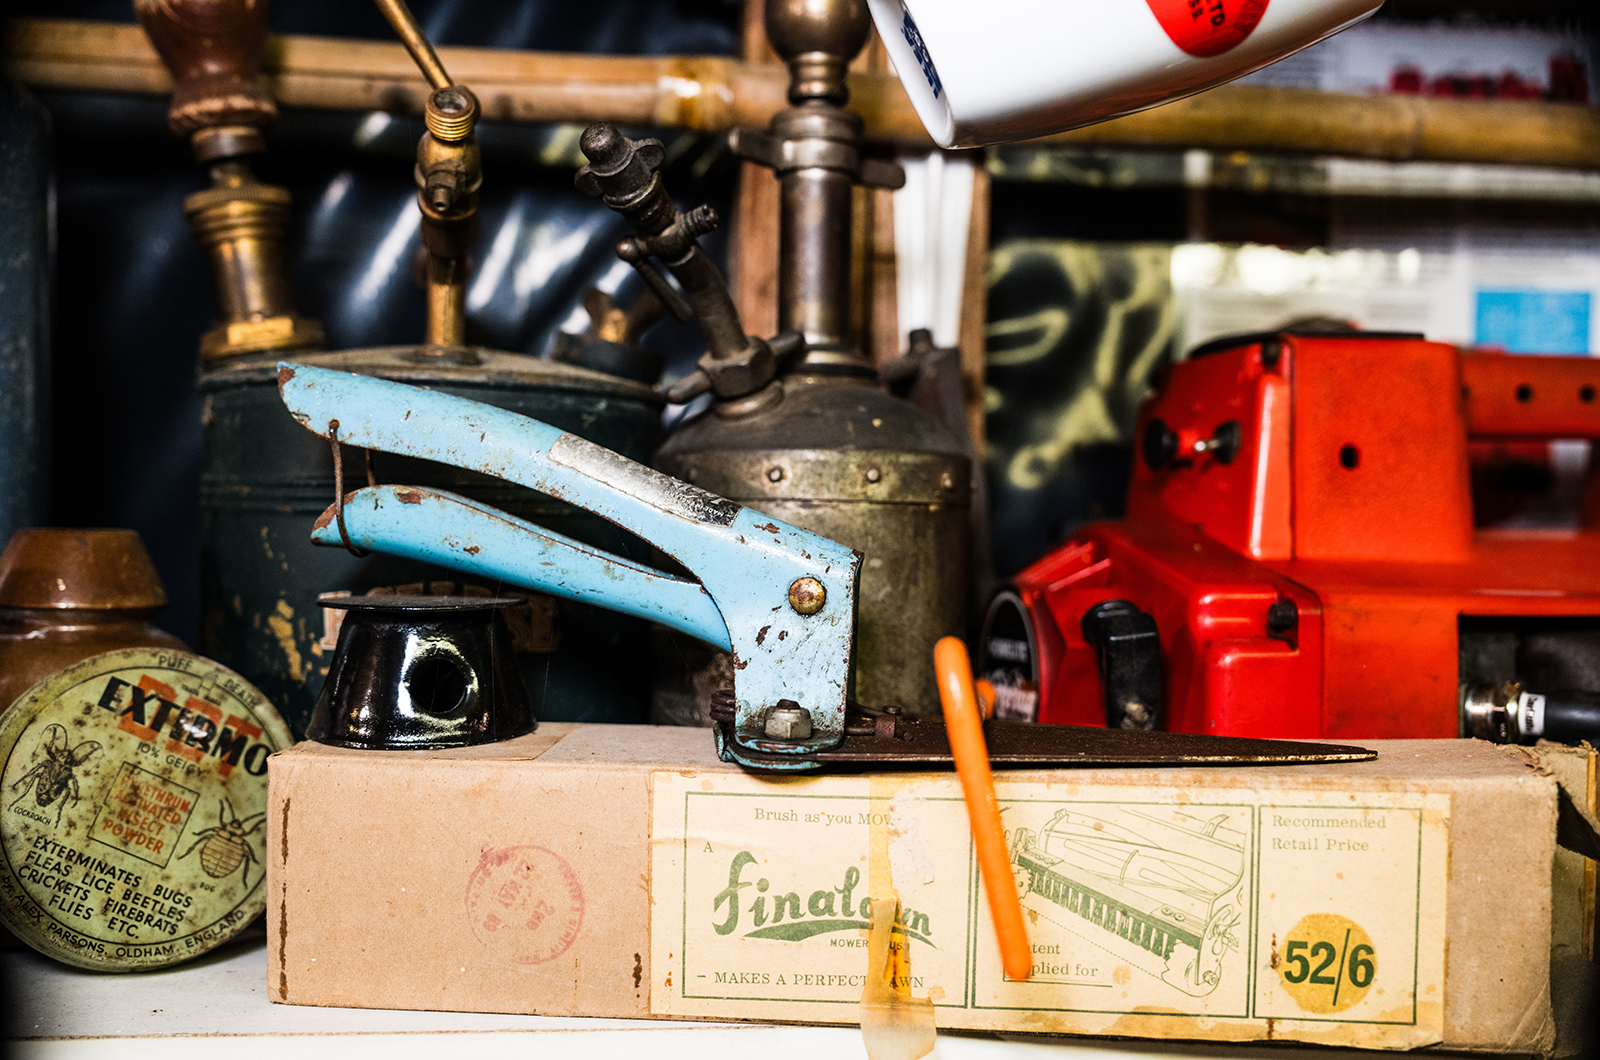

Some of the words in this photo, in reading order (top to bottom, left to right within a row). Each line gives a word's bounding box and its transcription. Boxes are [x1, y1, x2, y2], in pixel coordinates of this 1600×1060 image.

[158, 654, 194, 670] PUFF
[98, 676, 268, 776] EXTERMO
[137, 741, 160, 758] 10%
[13, 805, 52, 826] COCKROACH
[116, 806, 165, 836] INSECT
[754, 807, 799, 822] Brush
[804, 813, 821, 823] as
[825, 813, 853, 827] you
[1271, 813, 1387, 831] Recommended
[102, 818, 164, 854] POWDER
[1270, 836, 1319, 852] Retail
[1325, 838, 1370, 853] Price
[702, 841, 715, 854] A
[32, 835, 143, 888] EXTERMINATES
[152, 884, 193, 909] BUGS
[24, 850, 73, 877] FLEAS
[81, 872, 116, 895] LICE
[121, 888, 187, 923] BEETLES
[199, 881, 216, 893] BUG
[14, 893, 45, 923] ALEX
[18, 865, 91, 901] CRICKETS
[104, 898, 180, 936] FIREBRATS
[48, 894, 95, 921] FLIES
[107, 917, 140, 940] ETC.
[829, 938, 869, 948] MOWER
[1029, 942, 1061, 955] tent
[1030, 961, 1070, 978] plied
[1074, 963, 1099, 977] for
[1283, 927, 1376, 1007] 52/6
[714, 971, 771, 986] MAKES
[775, 973, 788, 986] A
[887, 976, 925, 989] AWN
